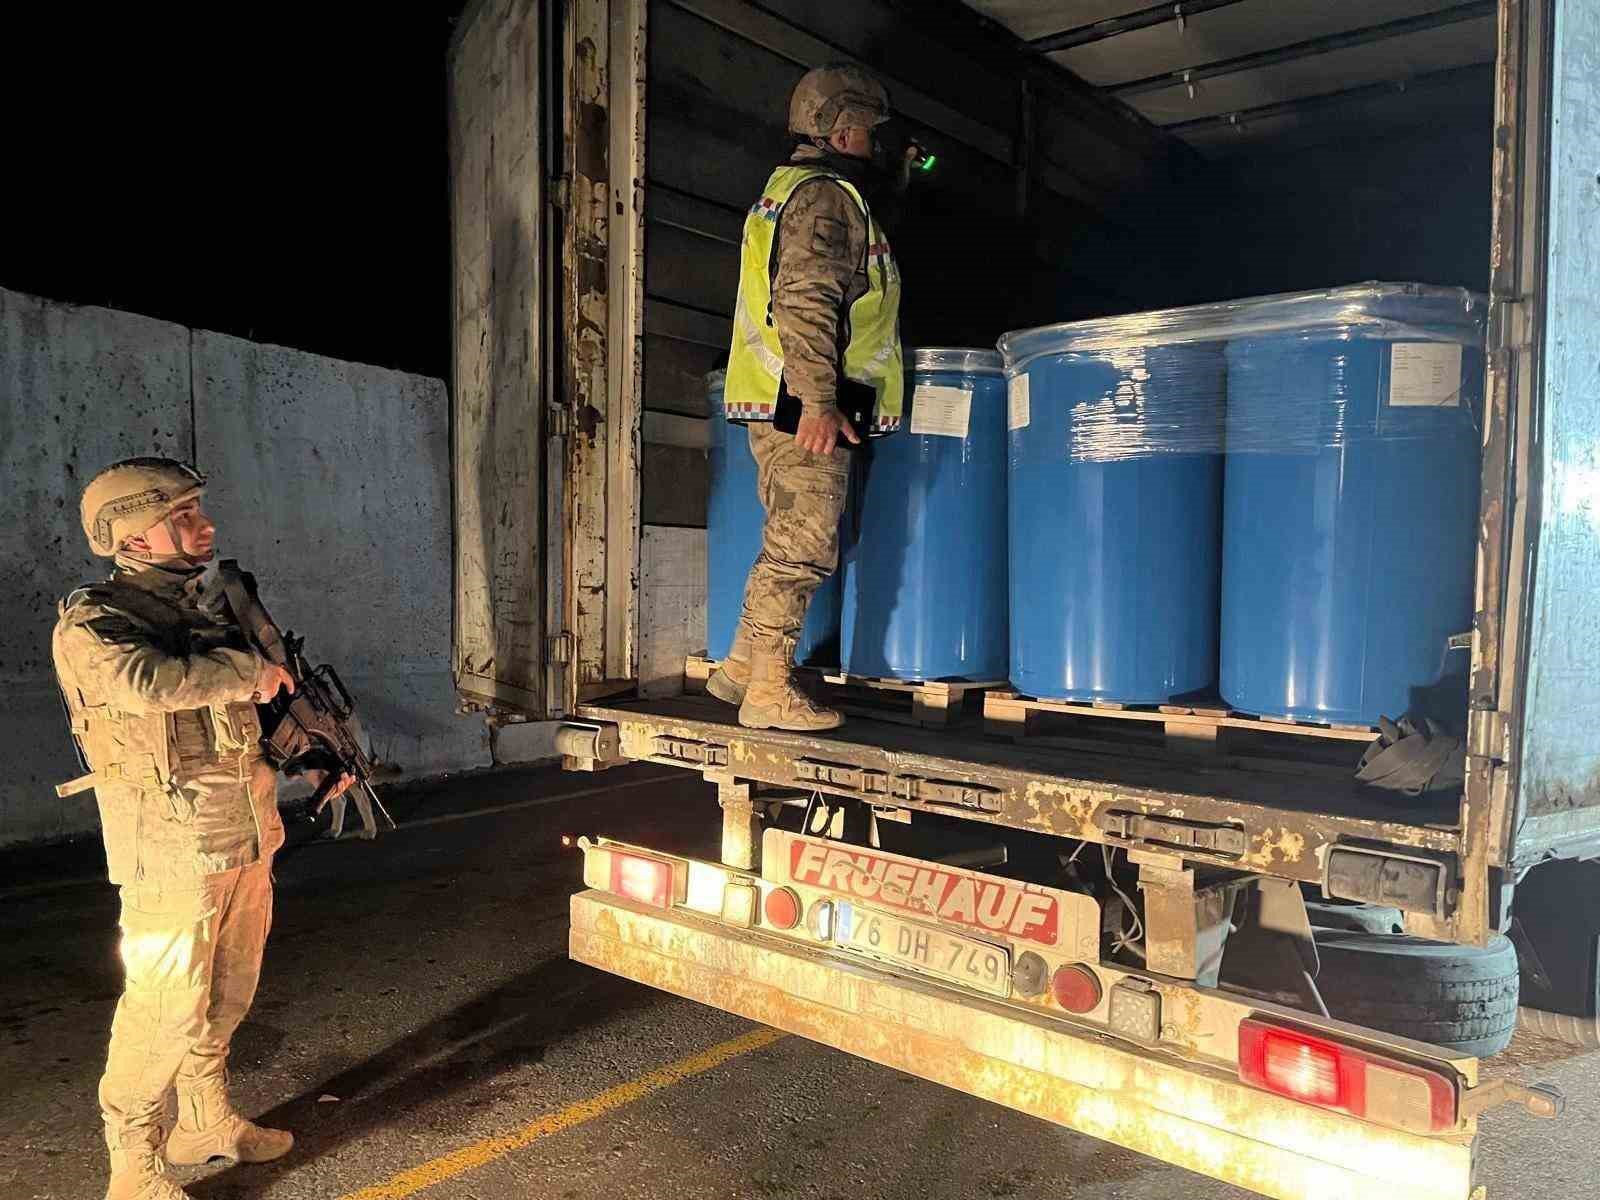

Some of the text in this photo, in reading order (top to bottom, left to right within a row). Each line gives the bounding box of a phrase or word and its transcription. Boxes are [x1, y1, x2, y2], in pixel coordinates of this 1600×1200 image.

[794, 844, 1053, 936] FRUEHAUF
[852, 911, 1000, 983] 76 DH 749
